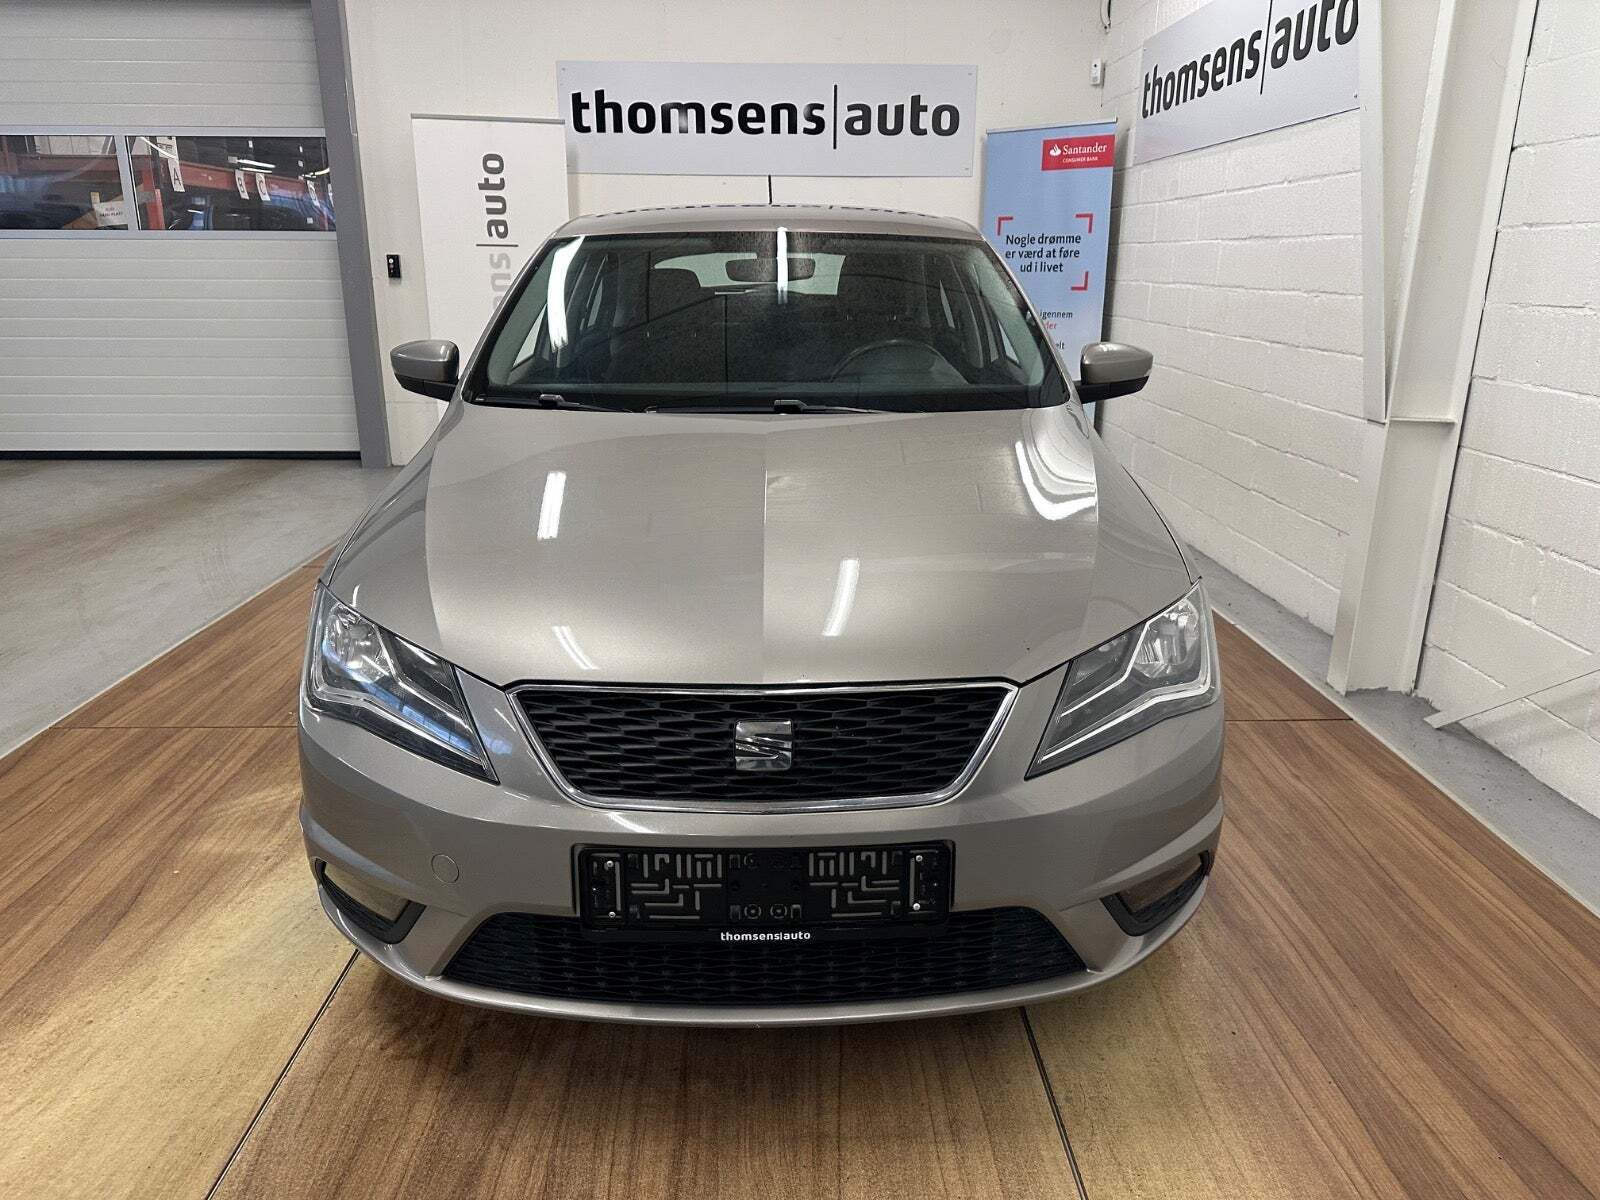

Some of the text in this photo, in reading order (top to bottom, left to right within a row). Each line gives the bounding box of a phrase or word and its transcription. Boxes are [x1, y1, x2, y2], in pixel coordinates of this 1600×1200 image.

[1062, 142, 1107, 155] Santander
[1006, 233, 1082, 248] Nogle drømme
[1005, 247, 1080, 259] er værd at føre
[1020, 261, 1032, 273] ud
[1040, 261, 1064, 273] livet
